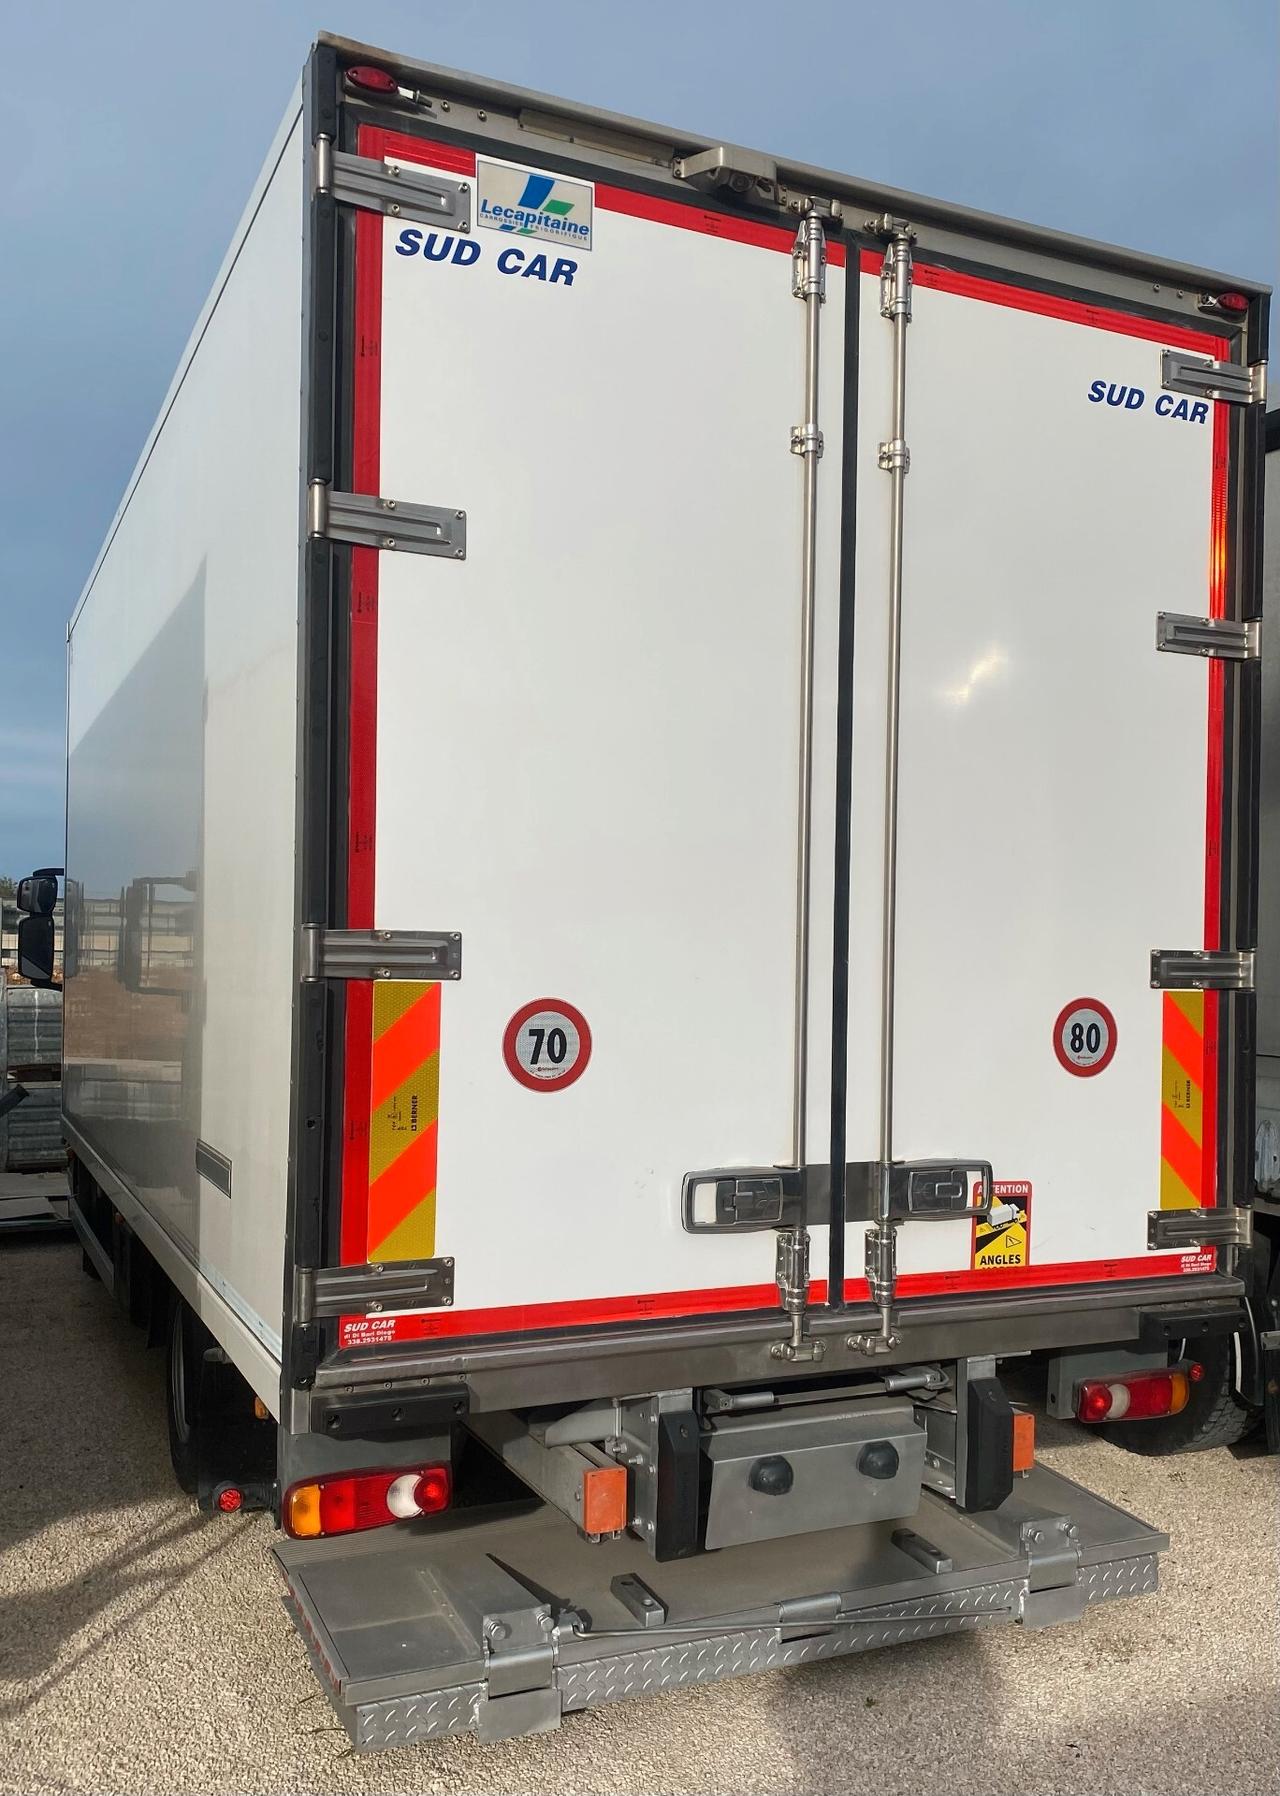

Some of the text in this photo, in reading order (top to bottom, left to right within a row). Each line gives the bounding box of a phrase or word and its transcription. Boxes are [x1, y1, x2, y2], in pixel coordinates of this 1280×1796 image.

[480, 198, 590, 235] Lecapitaine
[530, 224, 589, 241] FRIGORIFIQUE
[395, 229, 579, 286] SUD CAR
[1087, 380, 1209, 425] SUD CAR
[528, 1027, 567, 1065] 70
[1070, 1022, 1101, 1054] 80
[977, 1184, 1029, 1194] AENTION
[979, 1254, 1022, 1266] ANGLES
[1181, 1254, 1213, 1263] SUD CAR
[343, 1319, 396, 1333] SUD CAR
